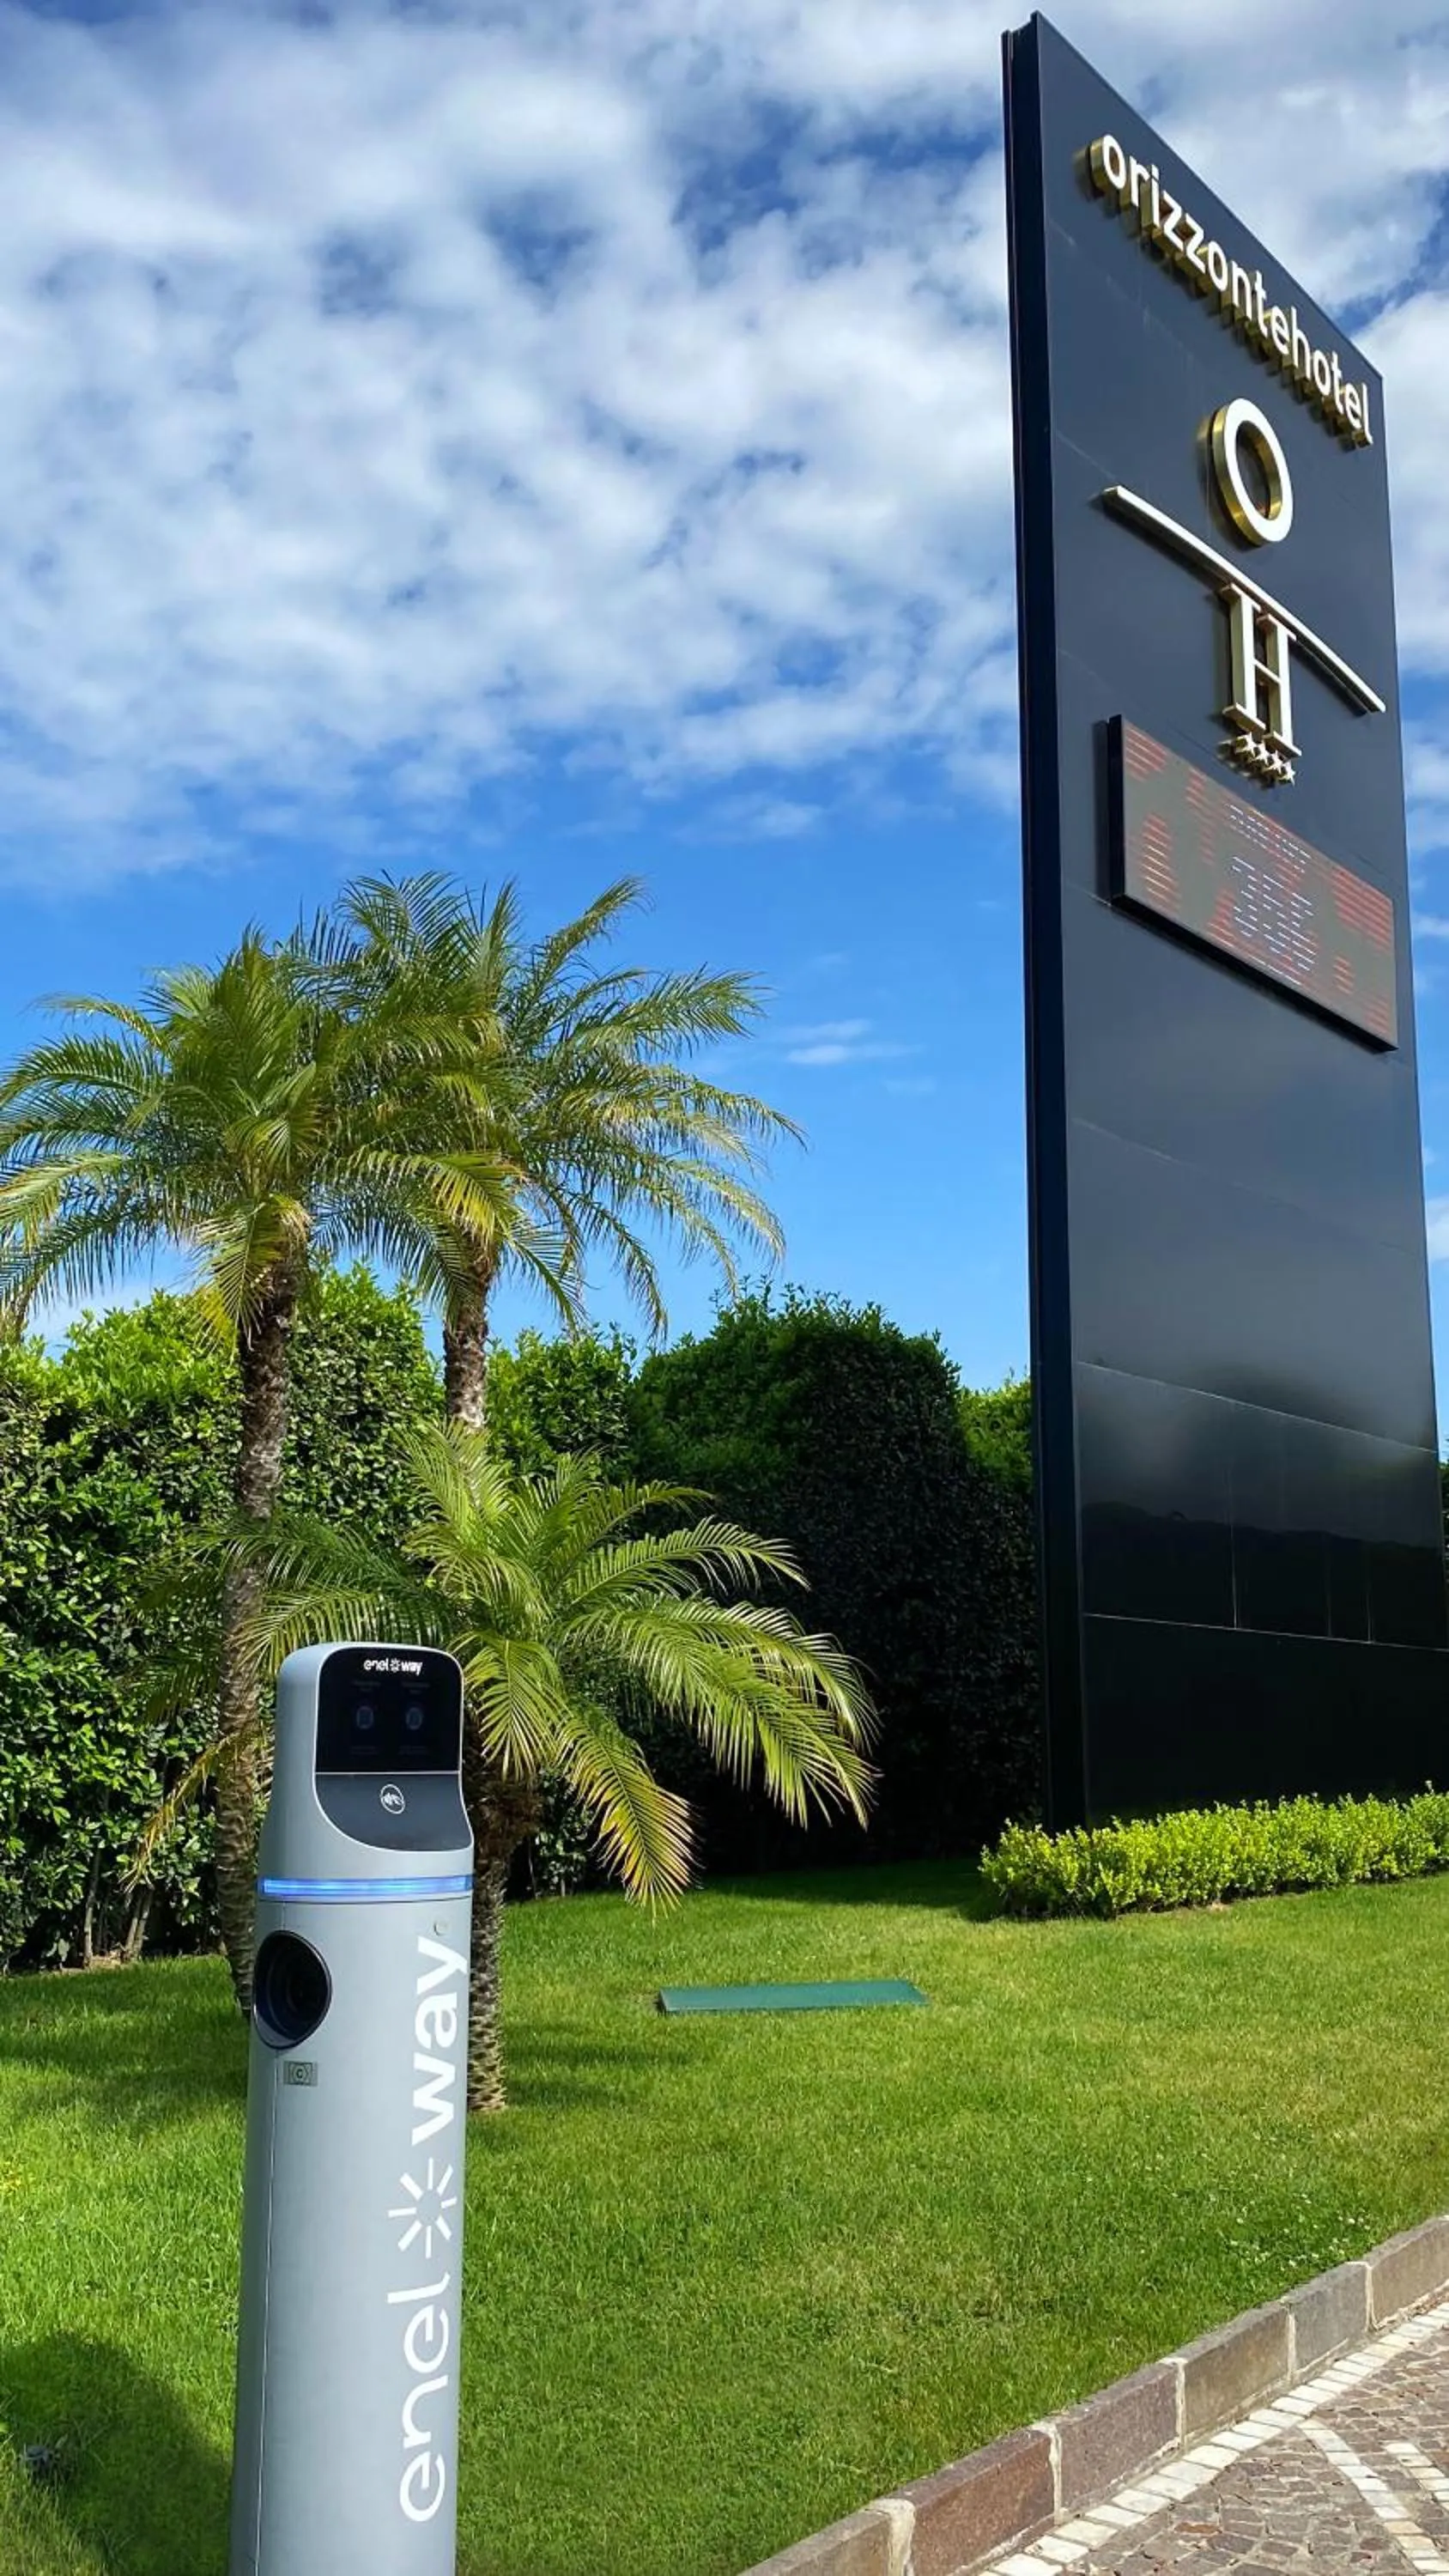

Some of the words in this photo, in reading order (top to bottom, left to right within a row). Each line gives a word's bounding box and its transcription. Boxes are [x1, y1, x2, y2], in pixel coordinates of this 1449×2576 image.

[1099, 135, 1374, 447] orizzontehotel
[364, 1657, 389, 1672] enel
[401, 1661, 423, 1675] way
[412, 1936, 469, 2146] way
[387, 2274, 451, 2522] enel
